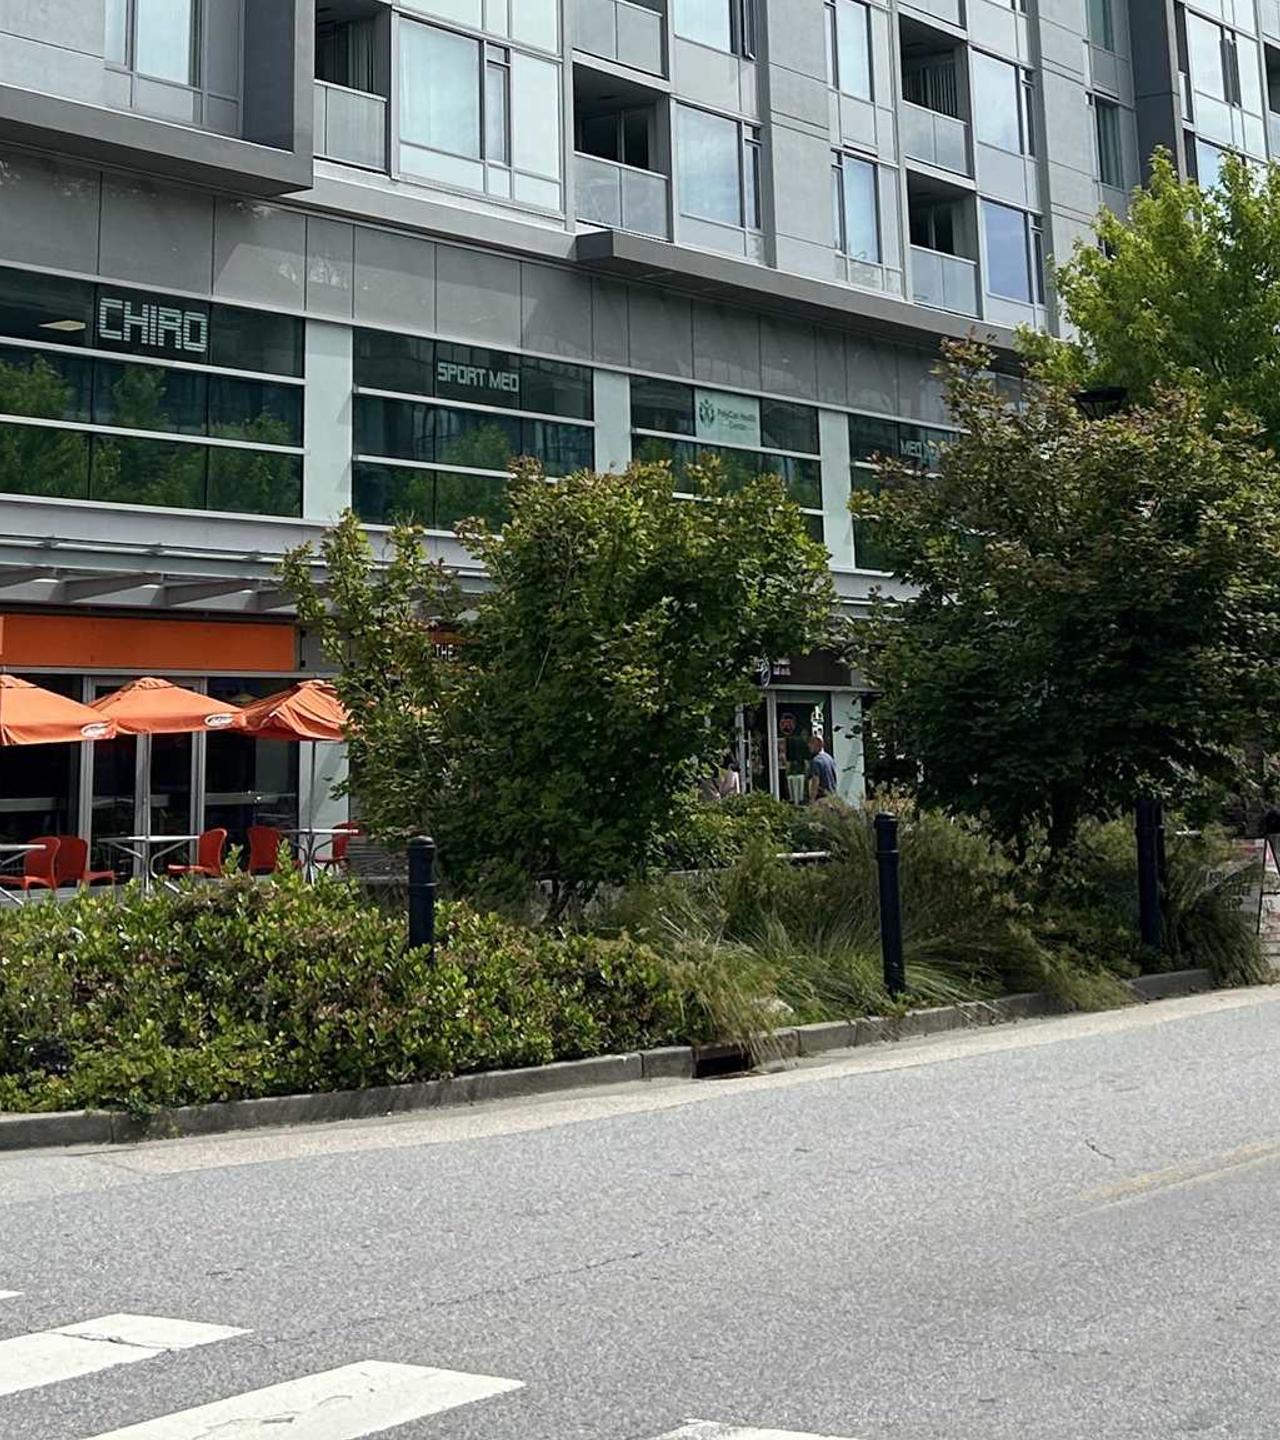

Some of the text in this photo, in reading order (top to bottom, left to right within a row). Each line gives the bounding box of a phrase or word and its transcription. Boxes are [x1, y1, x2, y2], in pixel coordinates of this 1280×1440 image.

[99, 297, 208, 353] CHIRO
[437, 361, 520, 393] SPORT MED
